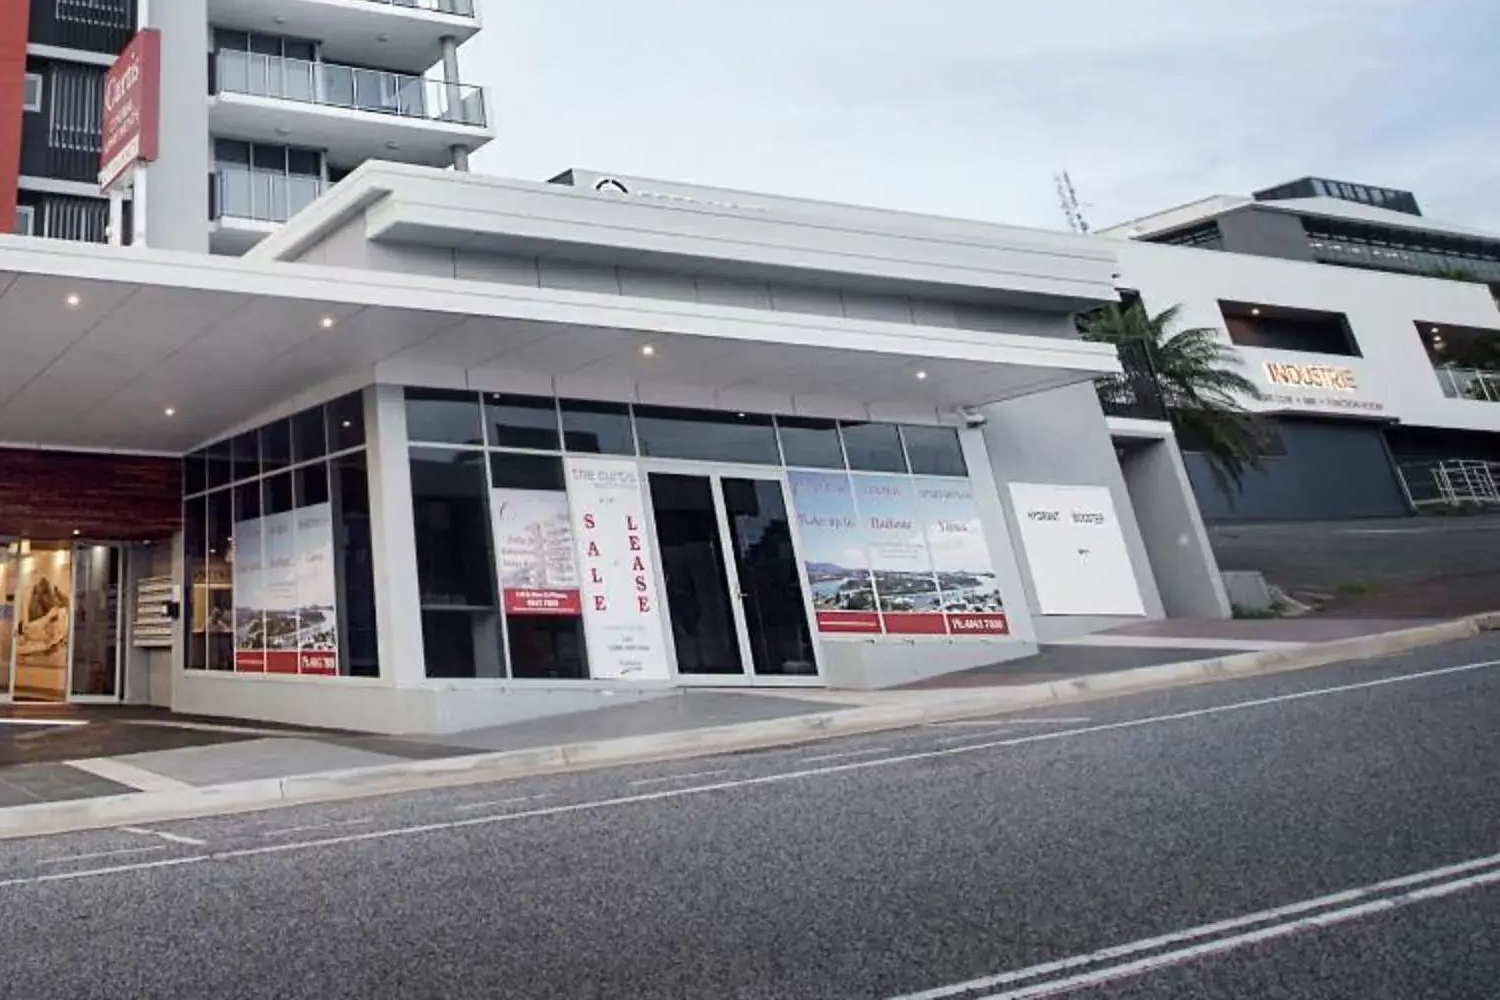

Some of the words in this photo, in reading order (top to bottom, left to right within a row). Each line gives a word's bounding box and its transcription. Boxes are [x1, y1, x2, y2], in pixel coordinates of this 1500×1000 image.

[1263, 362, 1358, 391] INDUSTRIE
[583, 513, 607, 611] SALE
[626, 515, 651, 613] LEASE
